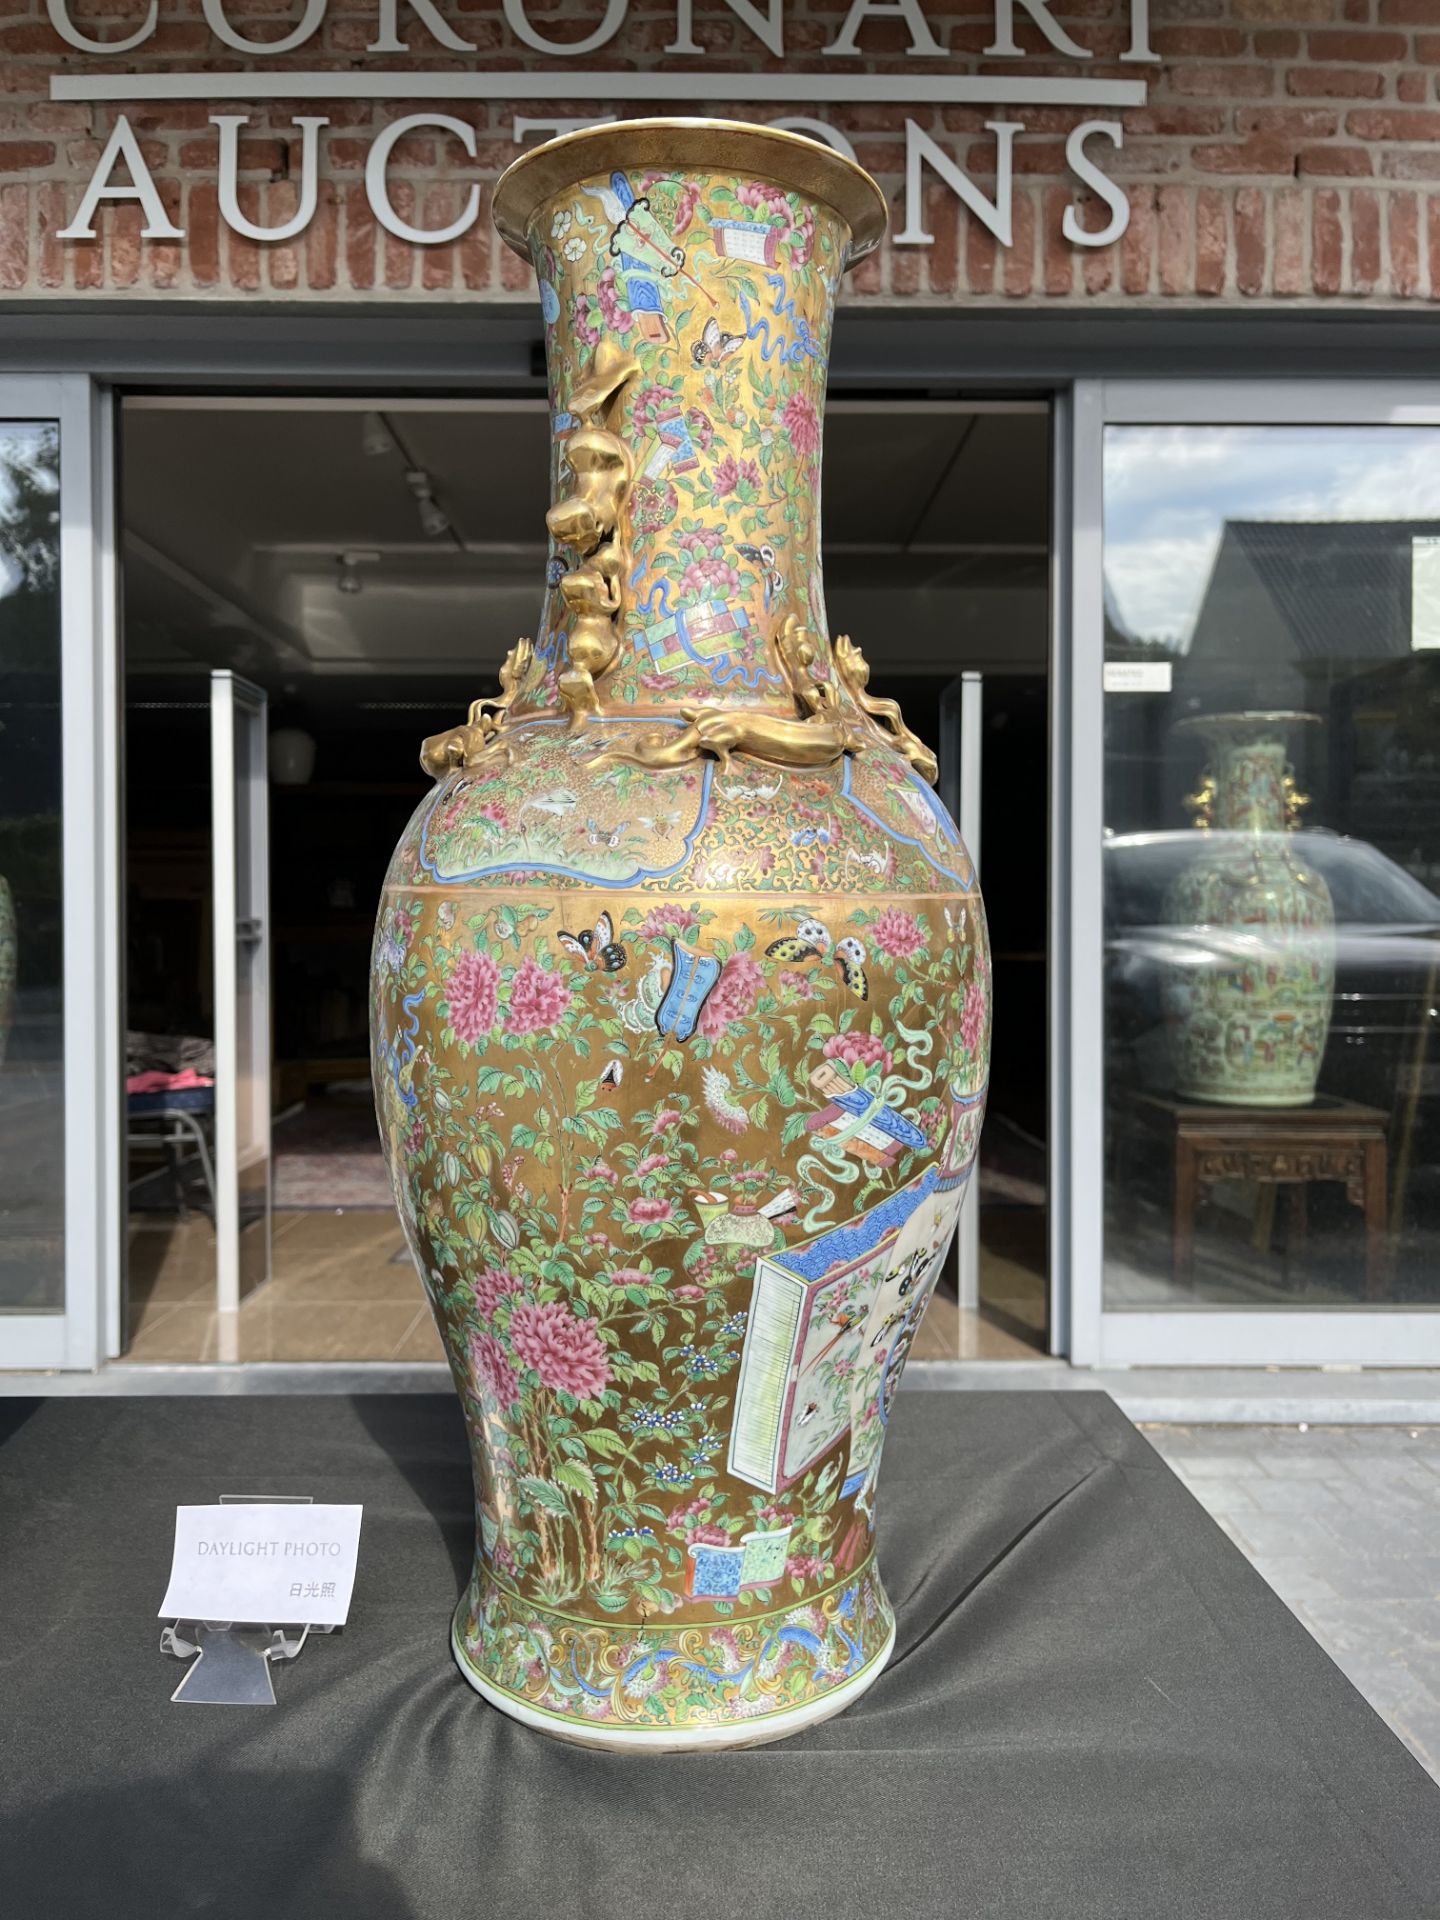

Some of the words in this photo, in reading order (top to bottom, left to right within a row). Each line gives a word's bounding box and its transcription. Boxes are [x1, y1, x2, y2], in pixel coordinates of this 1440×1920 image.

[55, 112, 1131, 249] AUCNS
[197, 1540, 279, 1556] DAYLIGHT
[284, 1541, 341, 1557] PHOTO
[289, 1582, 336, 1598] 日光照
